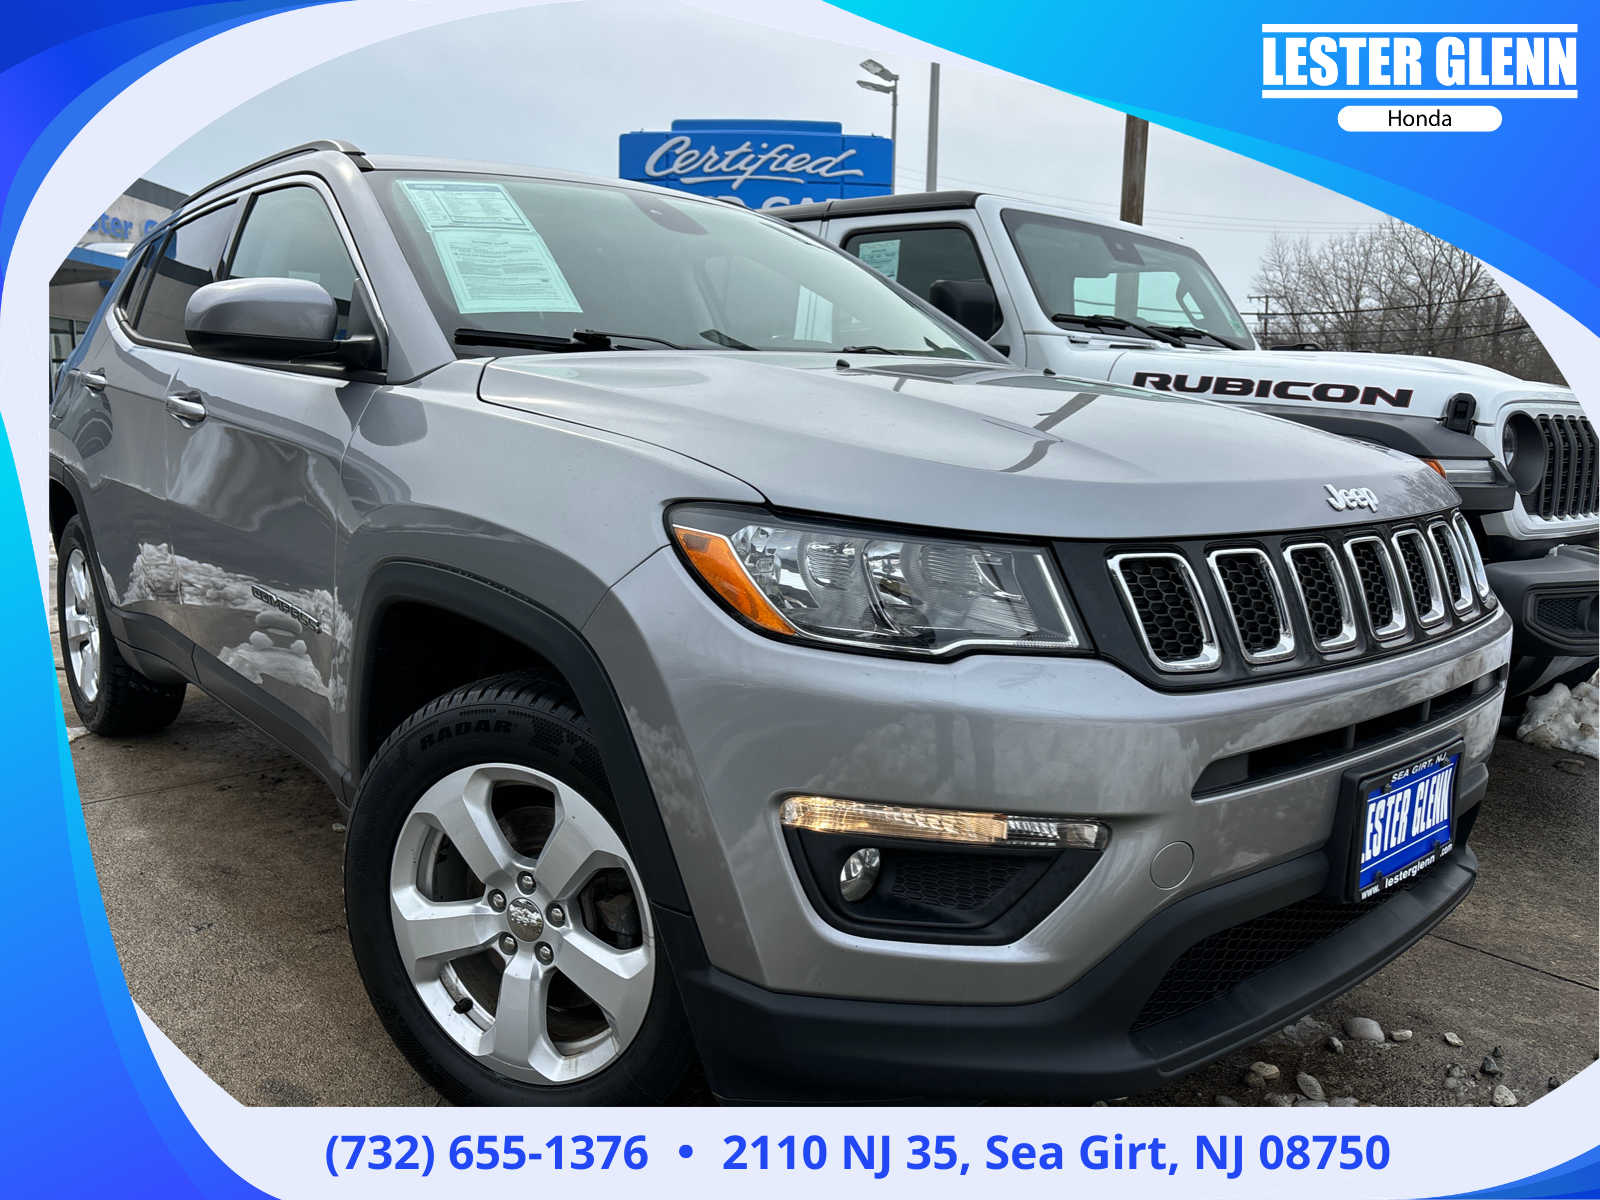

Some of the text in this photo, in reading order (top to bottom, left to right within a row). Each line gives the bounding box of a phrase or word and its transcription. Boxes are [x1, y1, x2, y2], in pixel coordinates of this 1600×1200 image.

[644, 135, 864, 190] Certified
[1132, 371, 1414, 408] RUBICON
[1323, 483, 1379, 513] Jeep
[419, 718, 513, 751] RADAR
[1391, 770, 1410, 783] SEA
[1411, 767, 1453, 837] GLENN
